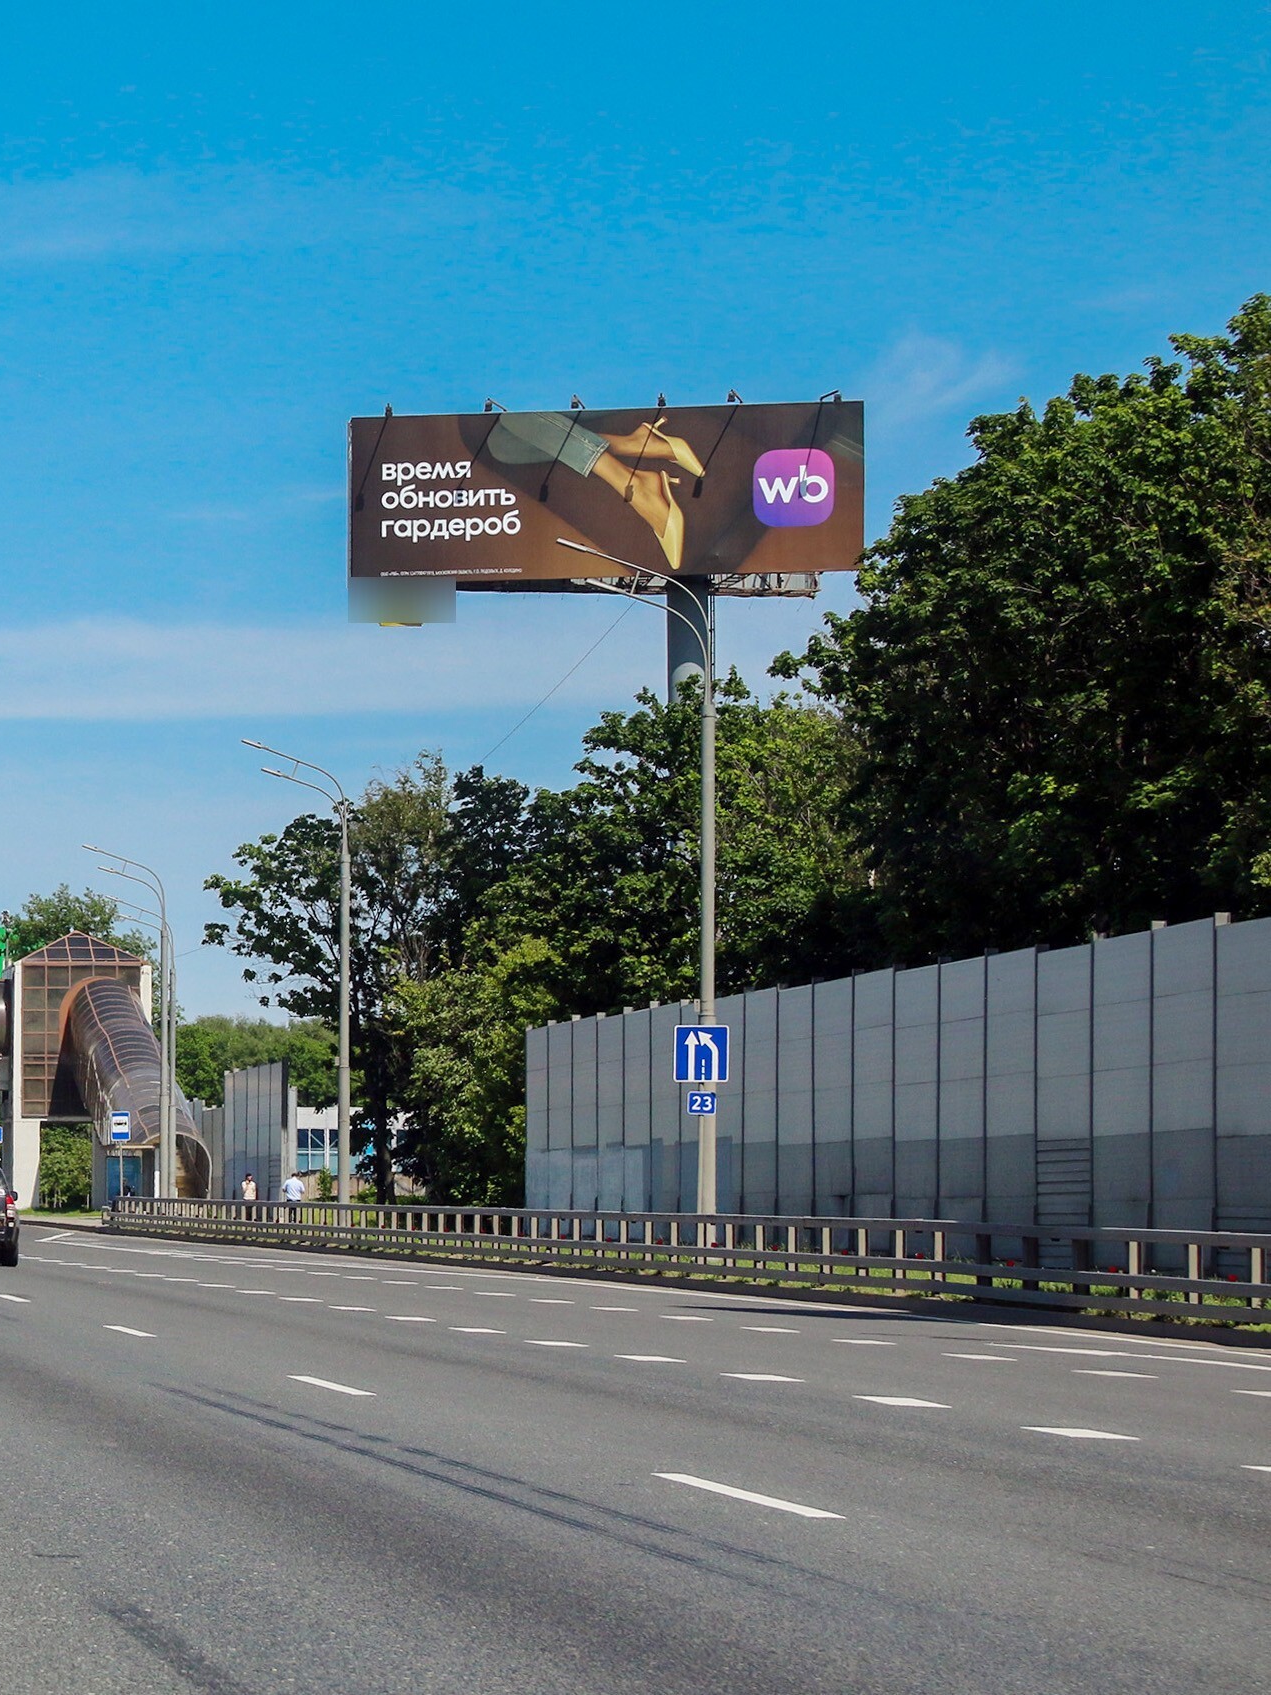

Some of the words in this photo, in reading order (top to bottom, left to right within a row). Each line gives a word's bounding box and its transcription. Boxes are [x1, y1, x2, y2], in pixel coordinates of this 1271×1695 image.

[381, 461, 472, 486] время
[757, 464, 829, 504] wb
[381, 484, 516, 509] обновить
[381, 509, 522, 543] гардероб
[691, 1095, 713, 1111] 23
